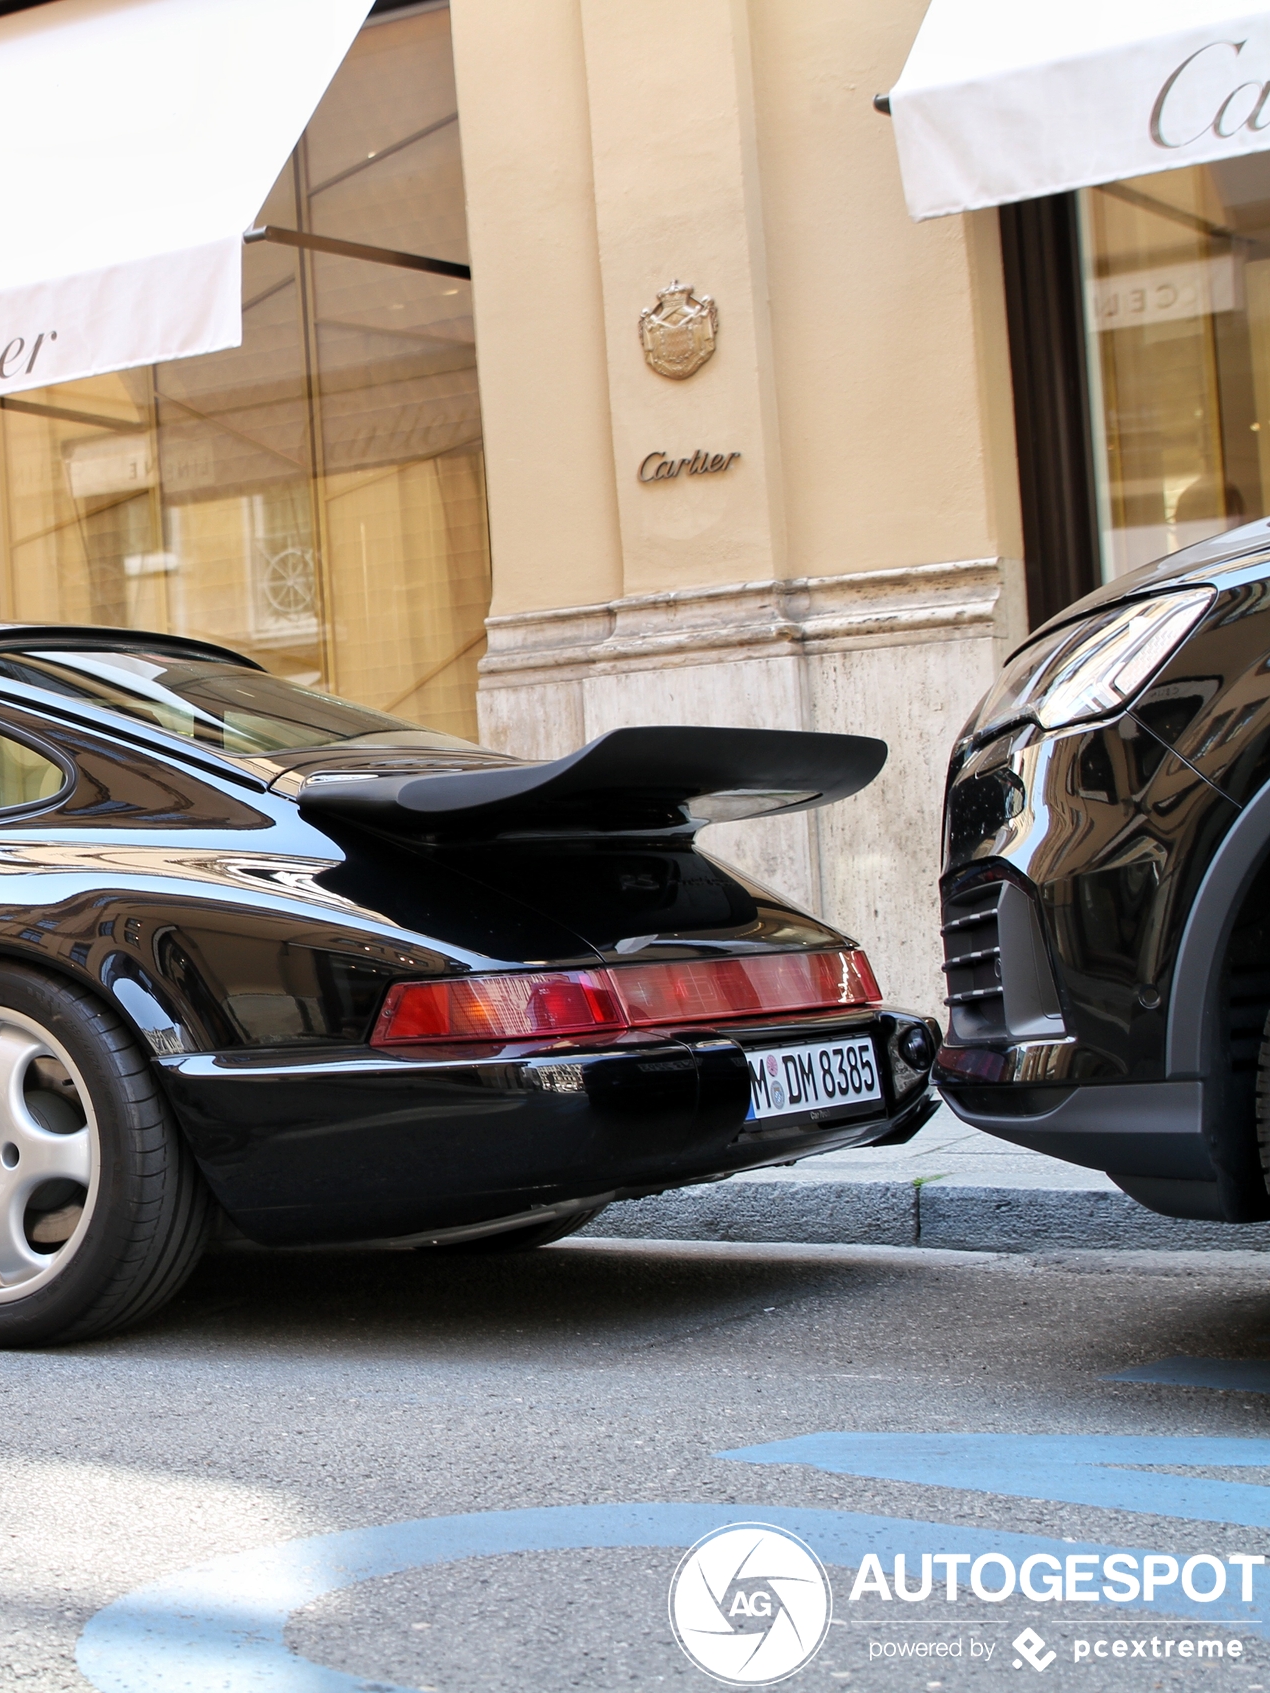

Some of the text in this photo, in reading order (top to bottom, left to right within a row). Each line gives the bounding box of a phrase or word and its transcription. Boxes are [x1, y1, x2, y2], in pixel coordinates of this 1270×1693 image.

[637, 449, 742, 482] Cartier
[748, 1045, 875, 1110] M DM 8385
